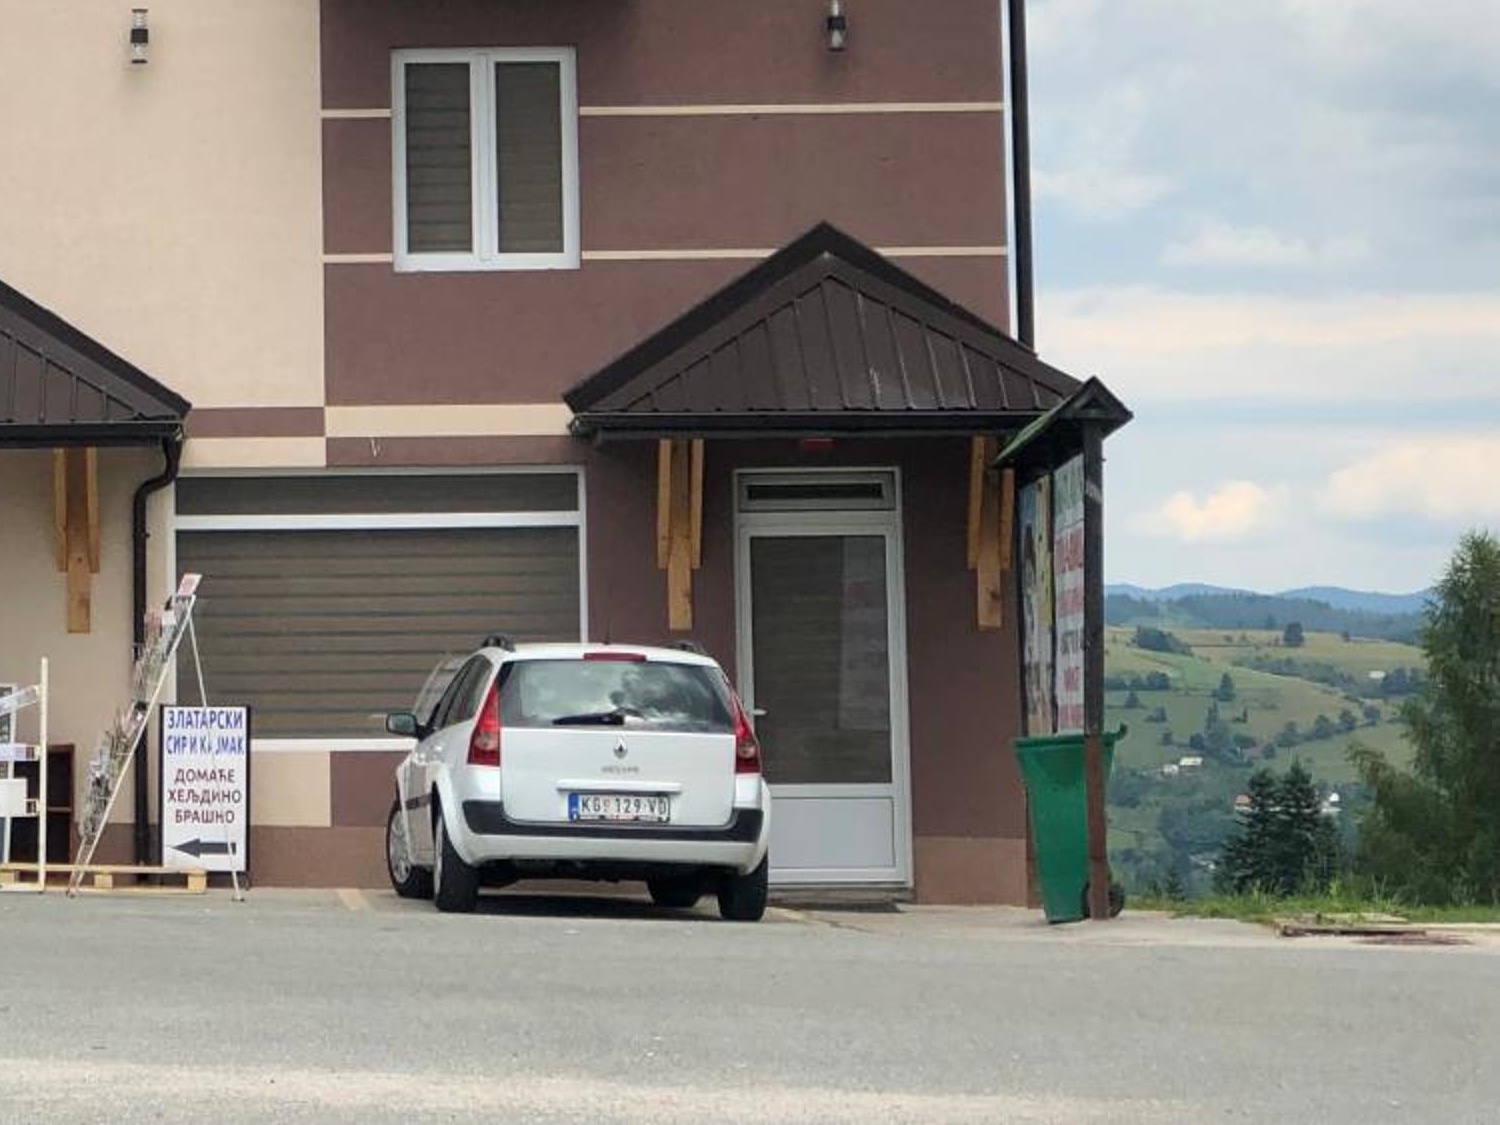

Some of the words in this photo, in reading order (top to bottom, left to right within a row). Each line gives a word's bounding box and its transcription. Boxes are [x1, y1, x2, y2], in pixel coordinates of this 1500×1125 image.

[167, 709, 243, 730] ЗЛАТАРСКИ
[166, 735, 187, 755] СИР
[189, 736, 198, 755] И
[174, 768, 235, 786] ДОМАЋЕ
[167, 789, 242, 806] ХЕЉДИНО
[581, 796, 601, 813] KG
[175, 809, 235, 825] БРАШНО
